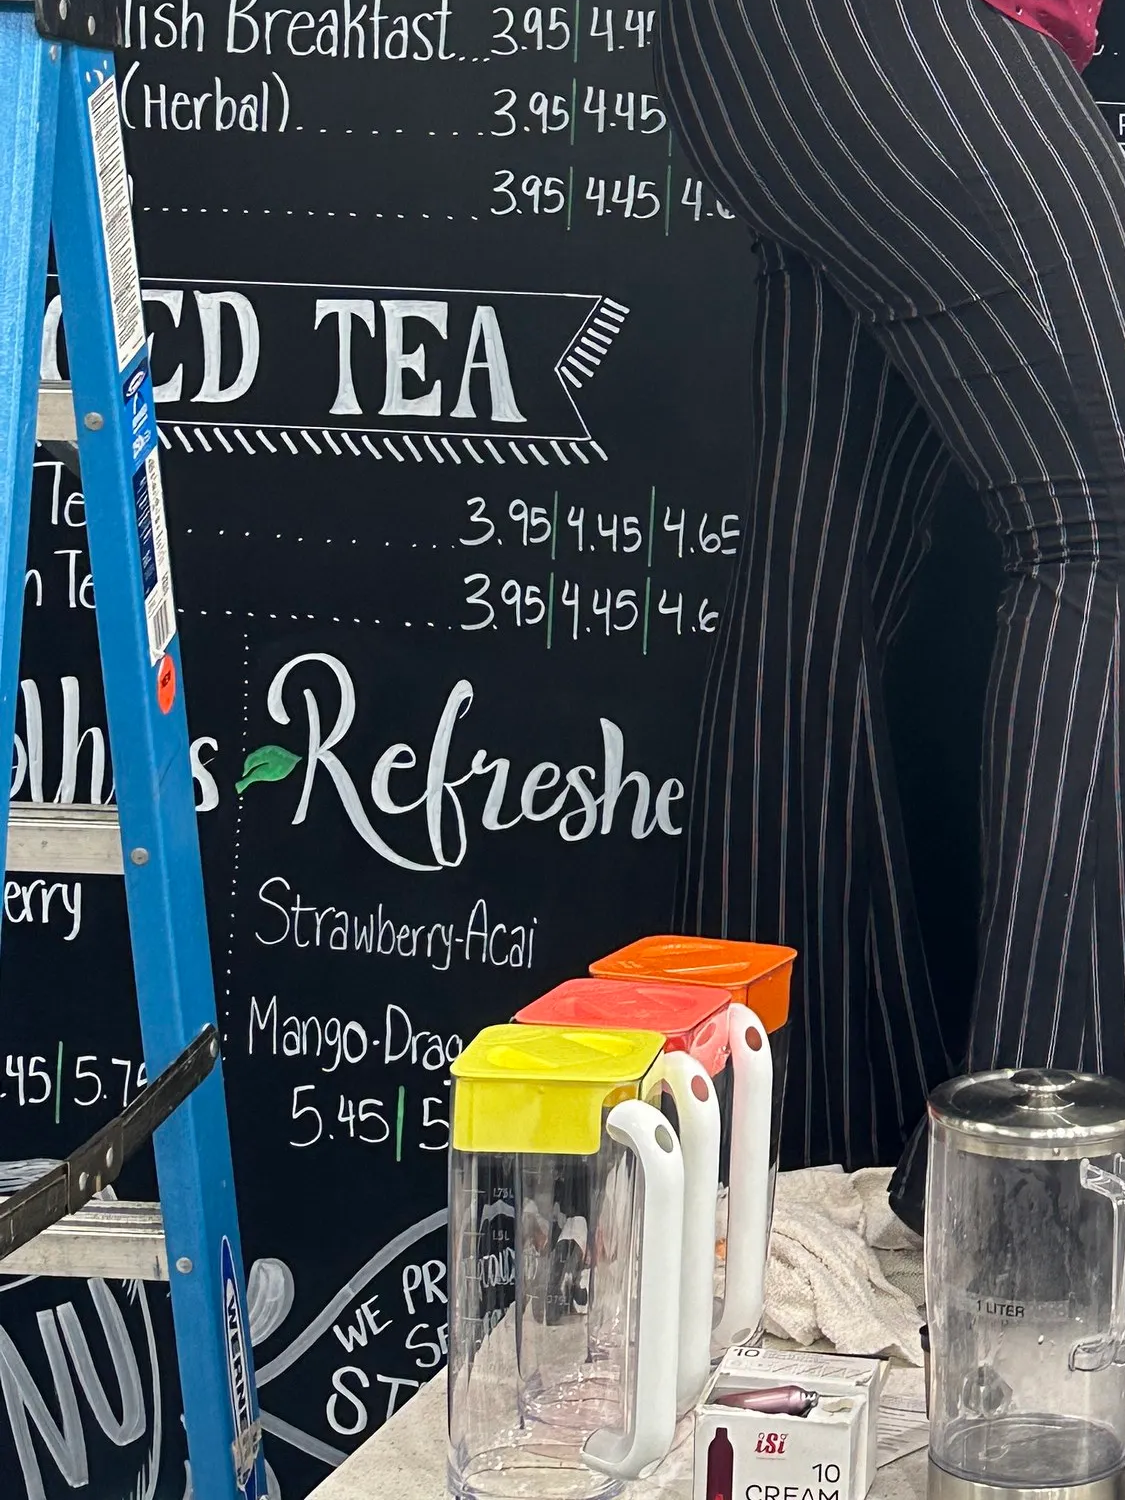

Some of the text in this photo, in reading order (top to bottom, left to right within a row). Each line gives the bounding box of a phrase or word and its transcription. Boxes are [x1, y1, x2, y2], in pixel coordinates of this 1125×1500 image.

[491, 7, 571, 56] 3.95
[121, 60, 667, 137] (Herbal) 3.95 4.45
[491, 169, 565, 216] 3.95
[586, 175, 660, 219] 4.45
[314, 298, 528, 423] TEA
[459, 496, 551, 547] 3.95
[567, 505, 642, 553] 4.45
[460, 573, 546, 631] 3.95
[561, 579, 639, 640] 4.45
[267, 652, 685, 872] Refreshe
[289, 1084, 390, 1148] 5.45
[332, 1294, 394, 1353] WE
[986, 1302, 1025, 1318] LITER
[225, 1294, 249, 1434] WERNE
[745, 1484, 839, 1500] CREAM
[812, 1463, 841, 1484] 10
